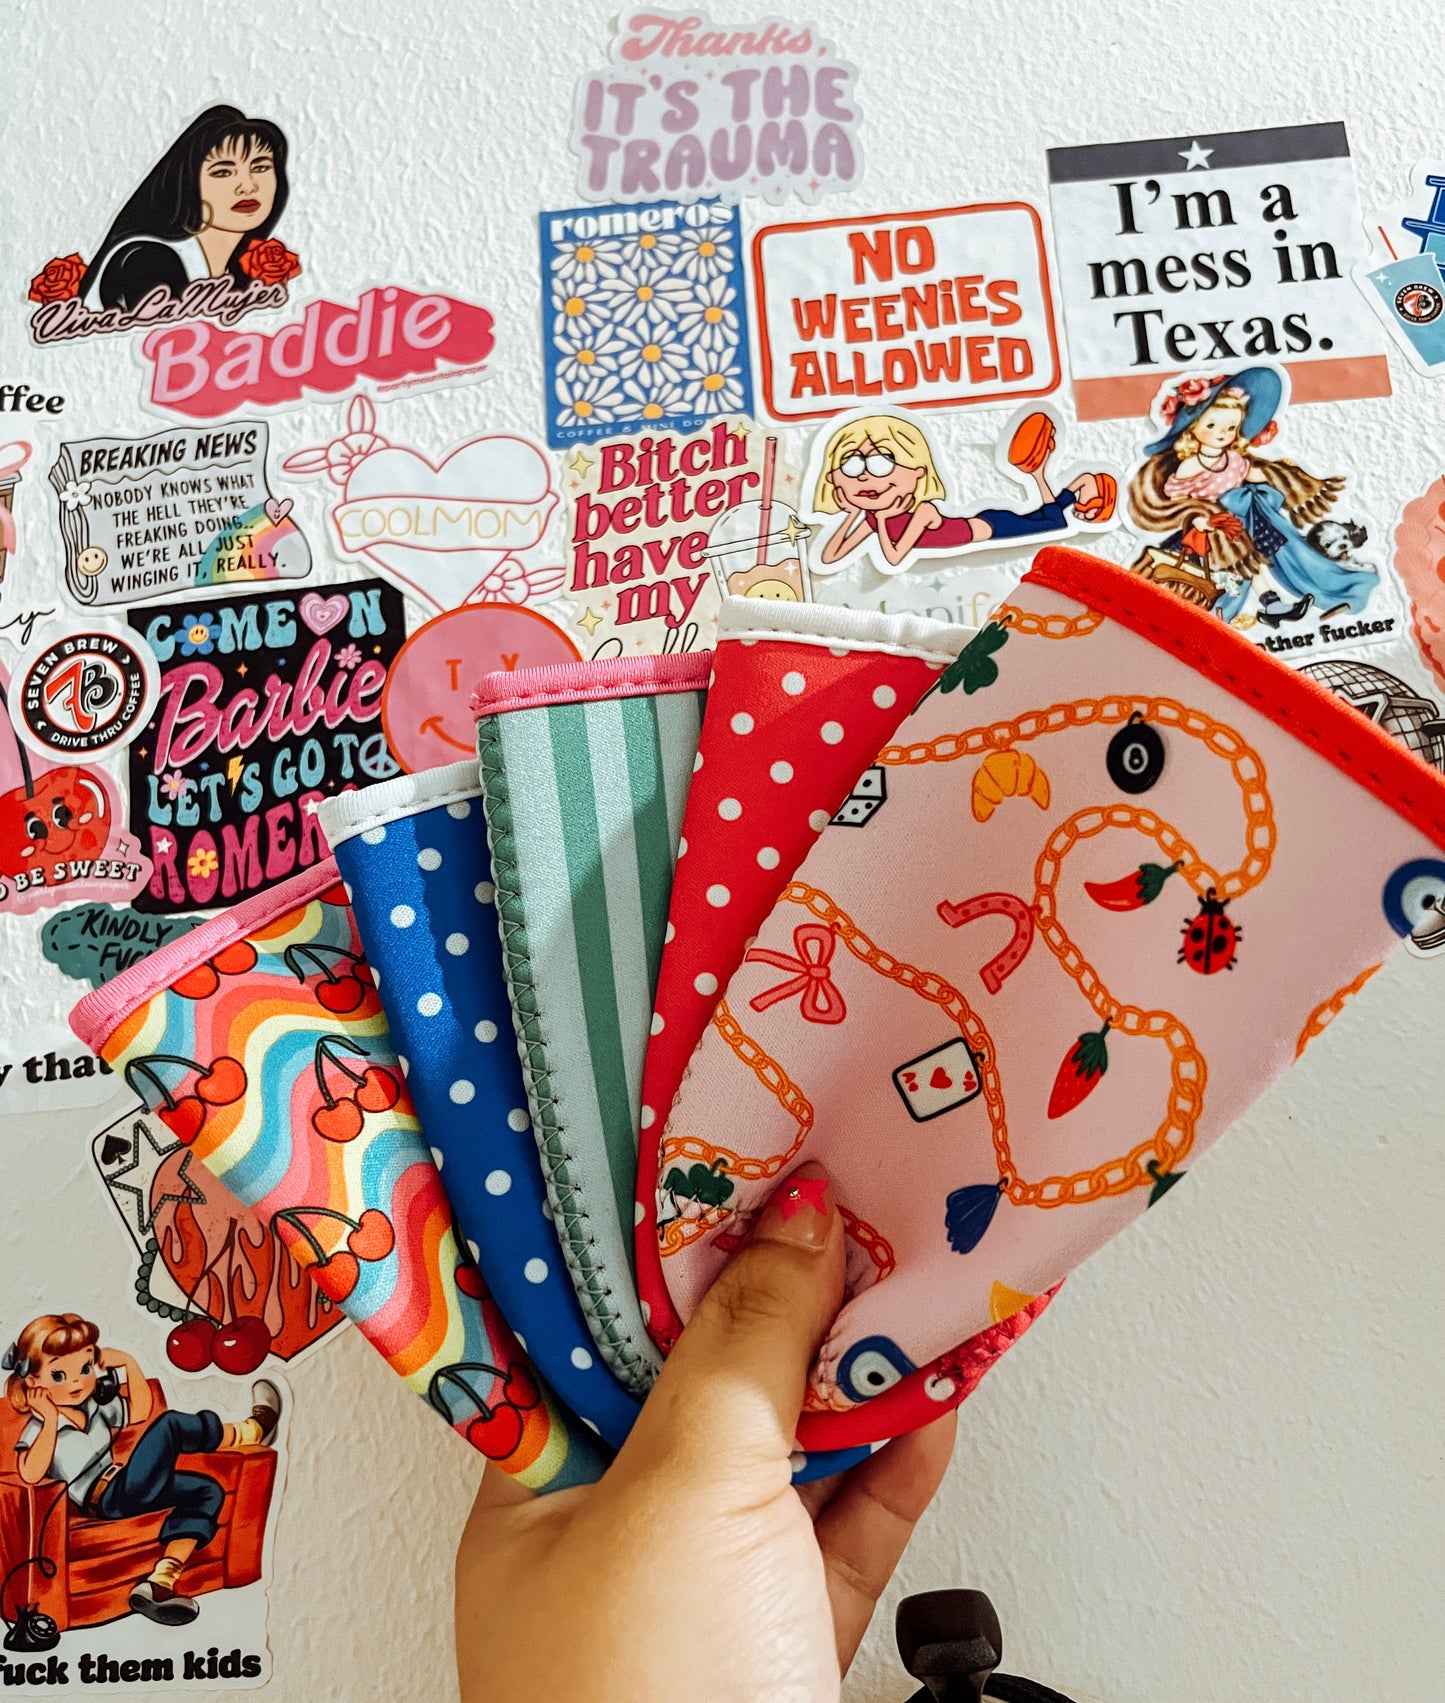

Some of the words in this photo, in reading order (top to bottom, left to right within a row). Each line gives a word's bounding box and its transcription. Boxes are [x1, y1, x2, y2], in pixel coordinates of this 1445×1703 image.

[620, 14, 826, 60] Thanks,
[584, 75, 699, 135] IT'S
[722, 65, 854, 122] THE
[582, 120, 856, 194] TRAUMA
[550, 202, 734, 242] romeros
[1109, 179, 1237, 236] I'm
[1260, 182, 1298, 223] a
[848, 226, 936, 284] NO
[1088, 243, 1252, 300] mess
[1273, 229, 1343, 284] in
[38, 300, 116, 339] Viva
[118, 286, 174, 325] La
[176, 276, 286, 323] Mujer
[143, 286, 452, 402] Baddie
[790, 336, 1033, 398] ALLOWED
[1113, 309, 1334, 367] Texas.
[79, 438, 187, 477] BREAKING
[194, 430, 258, 458] NEWS
[556, 427, 614, 439] COFFEE
[598, 422, 748, 494] Bitch
[92, 486, 152, 511] NOBODY
[160, 477, 213, 500] KNOWS
[217, 474, 256, 492] WHAT
[112, 511, 140, 528] THE
[147, 504, 182, 522] HELL
[188, 495, 250, 516] THEY'RE
[572, 471, 760, 543] better
[117, 522, 188, 549] FREAKING
[121, 547, 171, 570] WE'RE
[178, 540, 207, 558] ALL
[215, 534, 255, 552] JUST
[570, 531, 711, 592] have
[111, 567, 180, 594] WINGING
[615, 572, 710, 629] my
[1319, 618, 1395, 644] fucker
[27, 652, 59, 710] SEVEN
[64, 637, 119, 654] BREW
[51, 731, 88, 748] DRIVE
[90, 721, 123, 745] THRU
[123, 672, 141, 721] COFFEE
[154, 638, 388, 775] Barbie
[273, 738, 326, 798] GO
[14, 867, 45, 892] BE
[54, 859, 142, 881] SWEET
[149, 790, 334, 904] ROMER
[81, 909, 173, 947] KINDLY
[78, 1652, 175, 1684] them
[183, 1647, 262, 1680] kids
